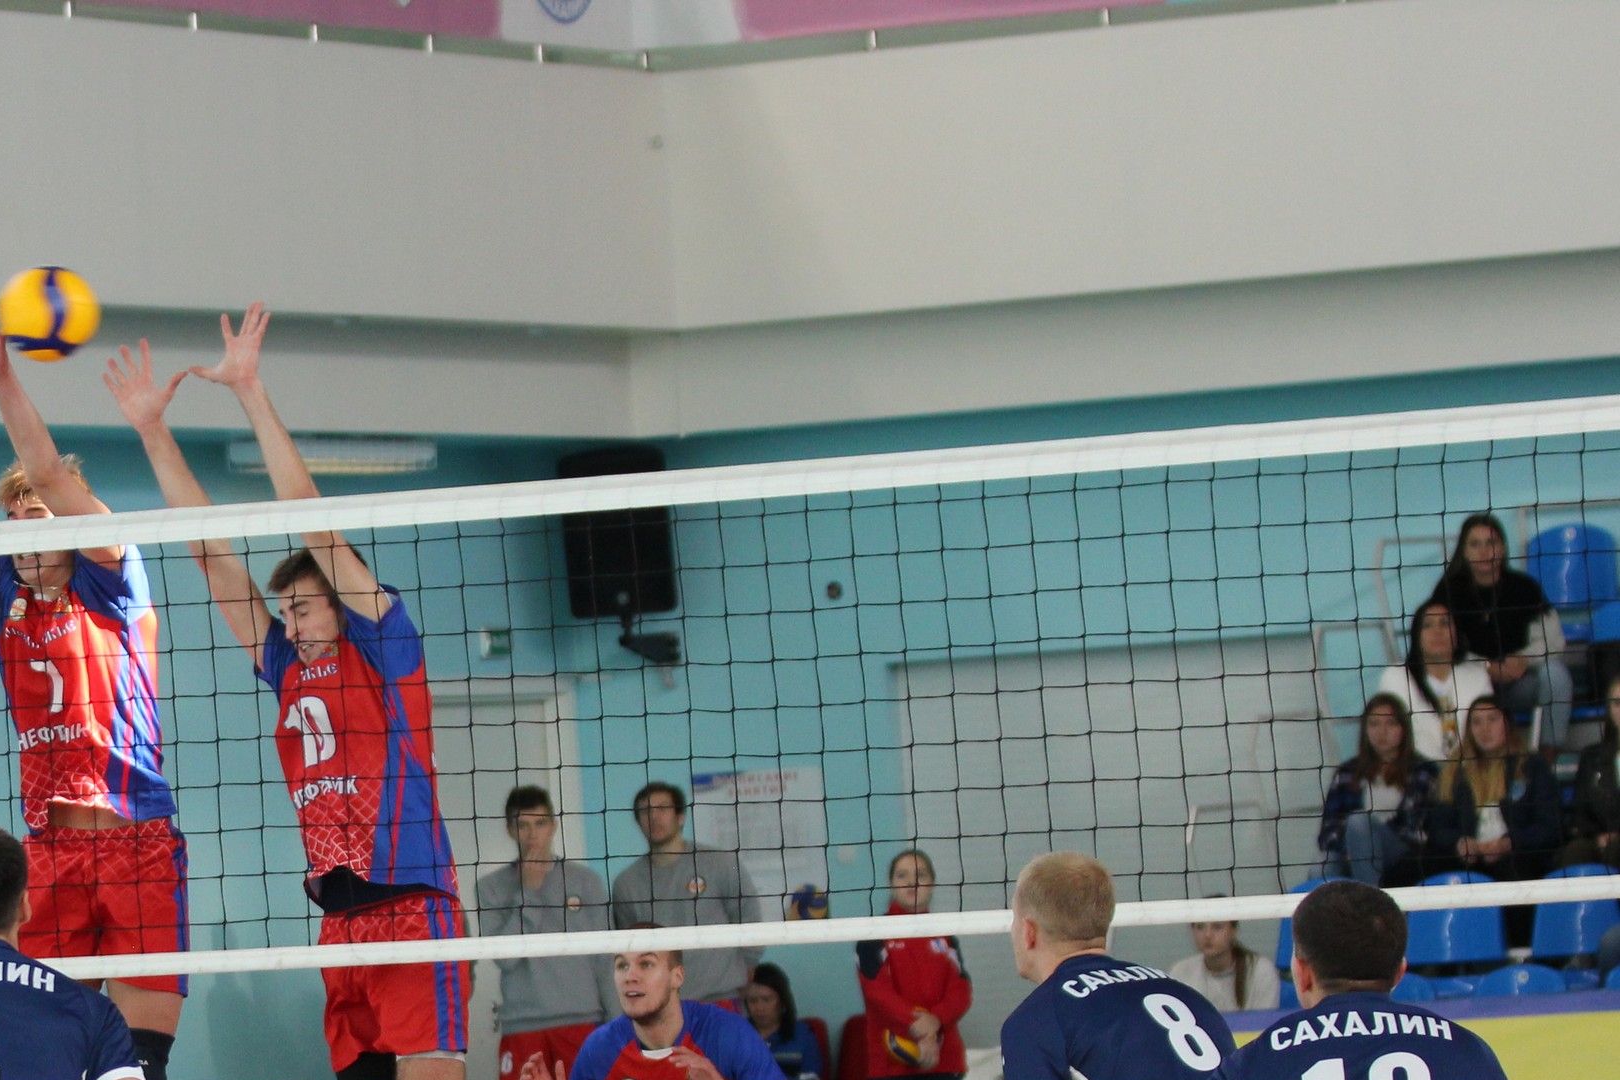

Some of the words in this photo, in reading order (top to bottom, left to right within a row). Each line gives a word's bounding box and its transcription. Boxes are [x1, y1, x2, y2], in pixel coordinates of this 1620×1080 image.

[30, 659, 64, 713] 7
[284, 695, 337, 768] 10
[1143, 993, 1222, 1071] 8
[1270, 1010, 1453, 1051] САХАЛИН
